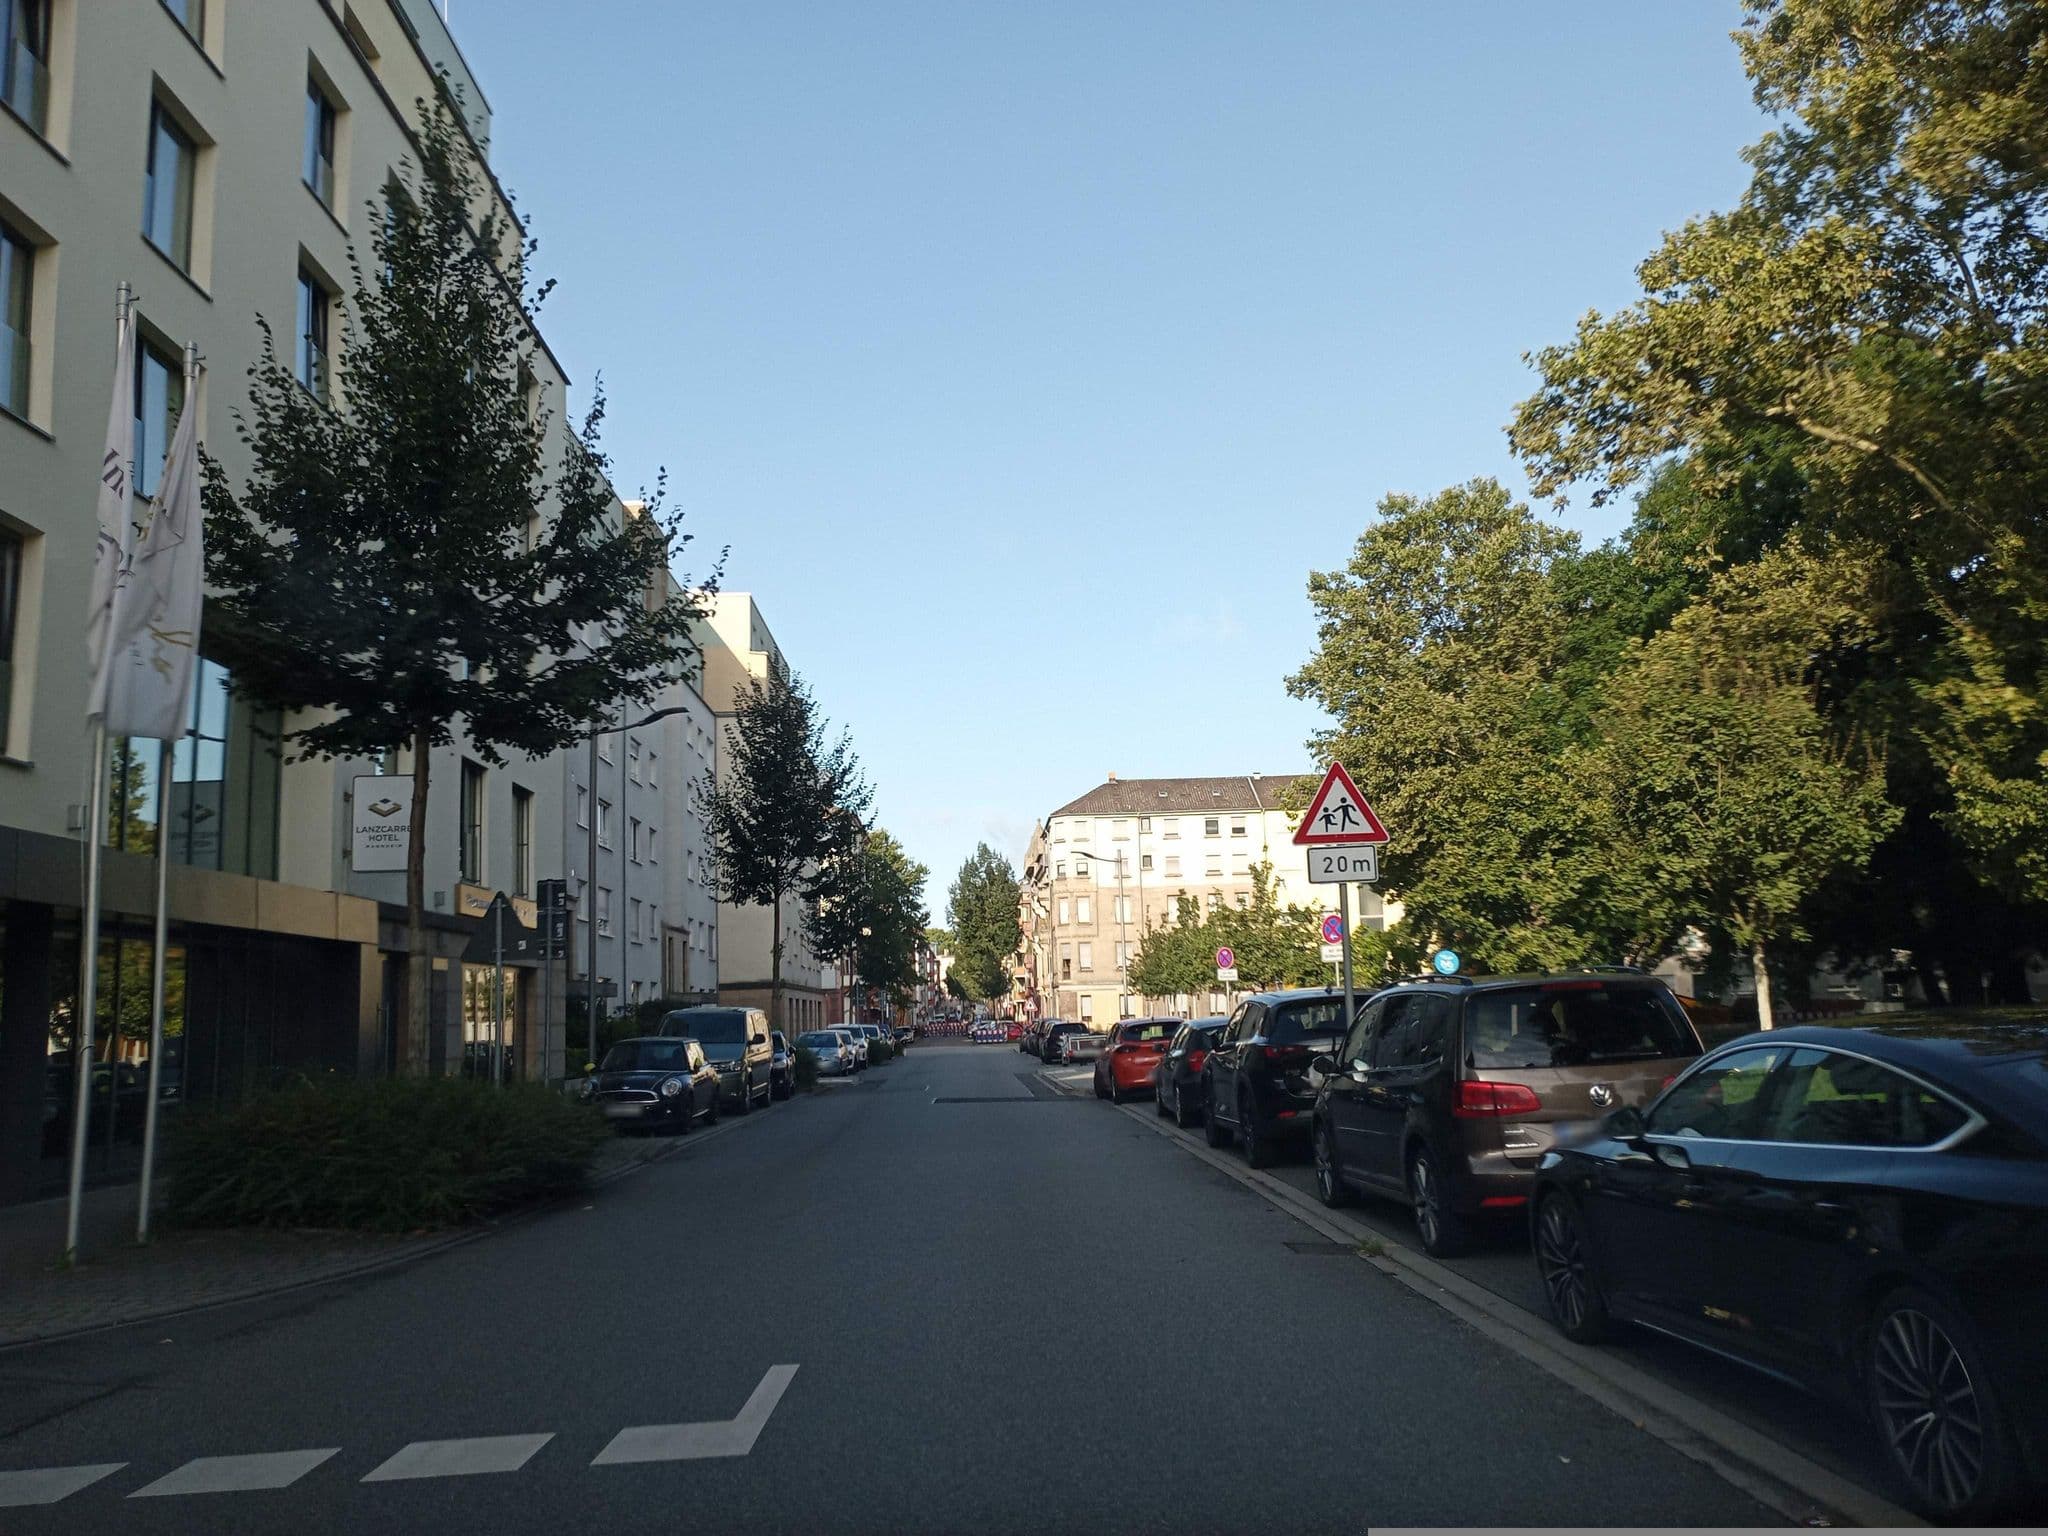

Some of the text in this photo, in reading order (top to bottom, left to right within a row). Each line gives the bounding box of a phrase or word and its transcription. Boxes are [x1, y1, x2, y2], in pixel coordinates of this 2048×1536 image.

[368, 834, 400, 842] HOTEL
[1323, 855, 1371, 874] 20 m
